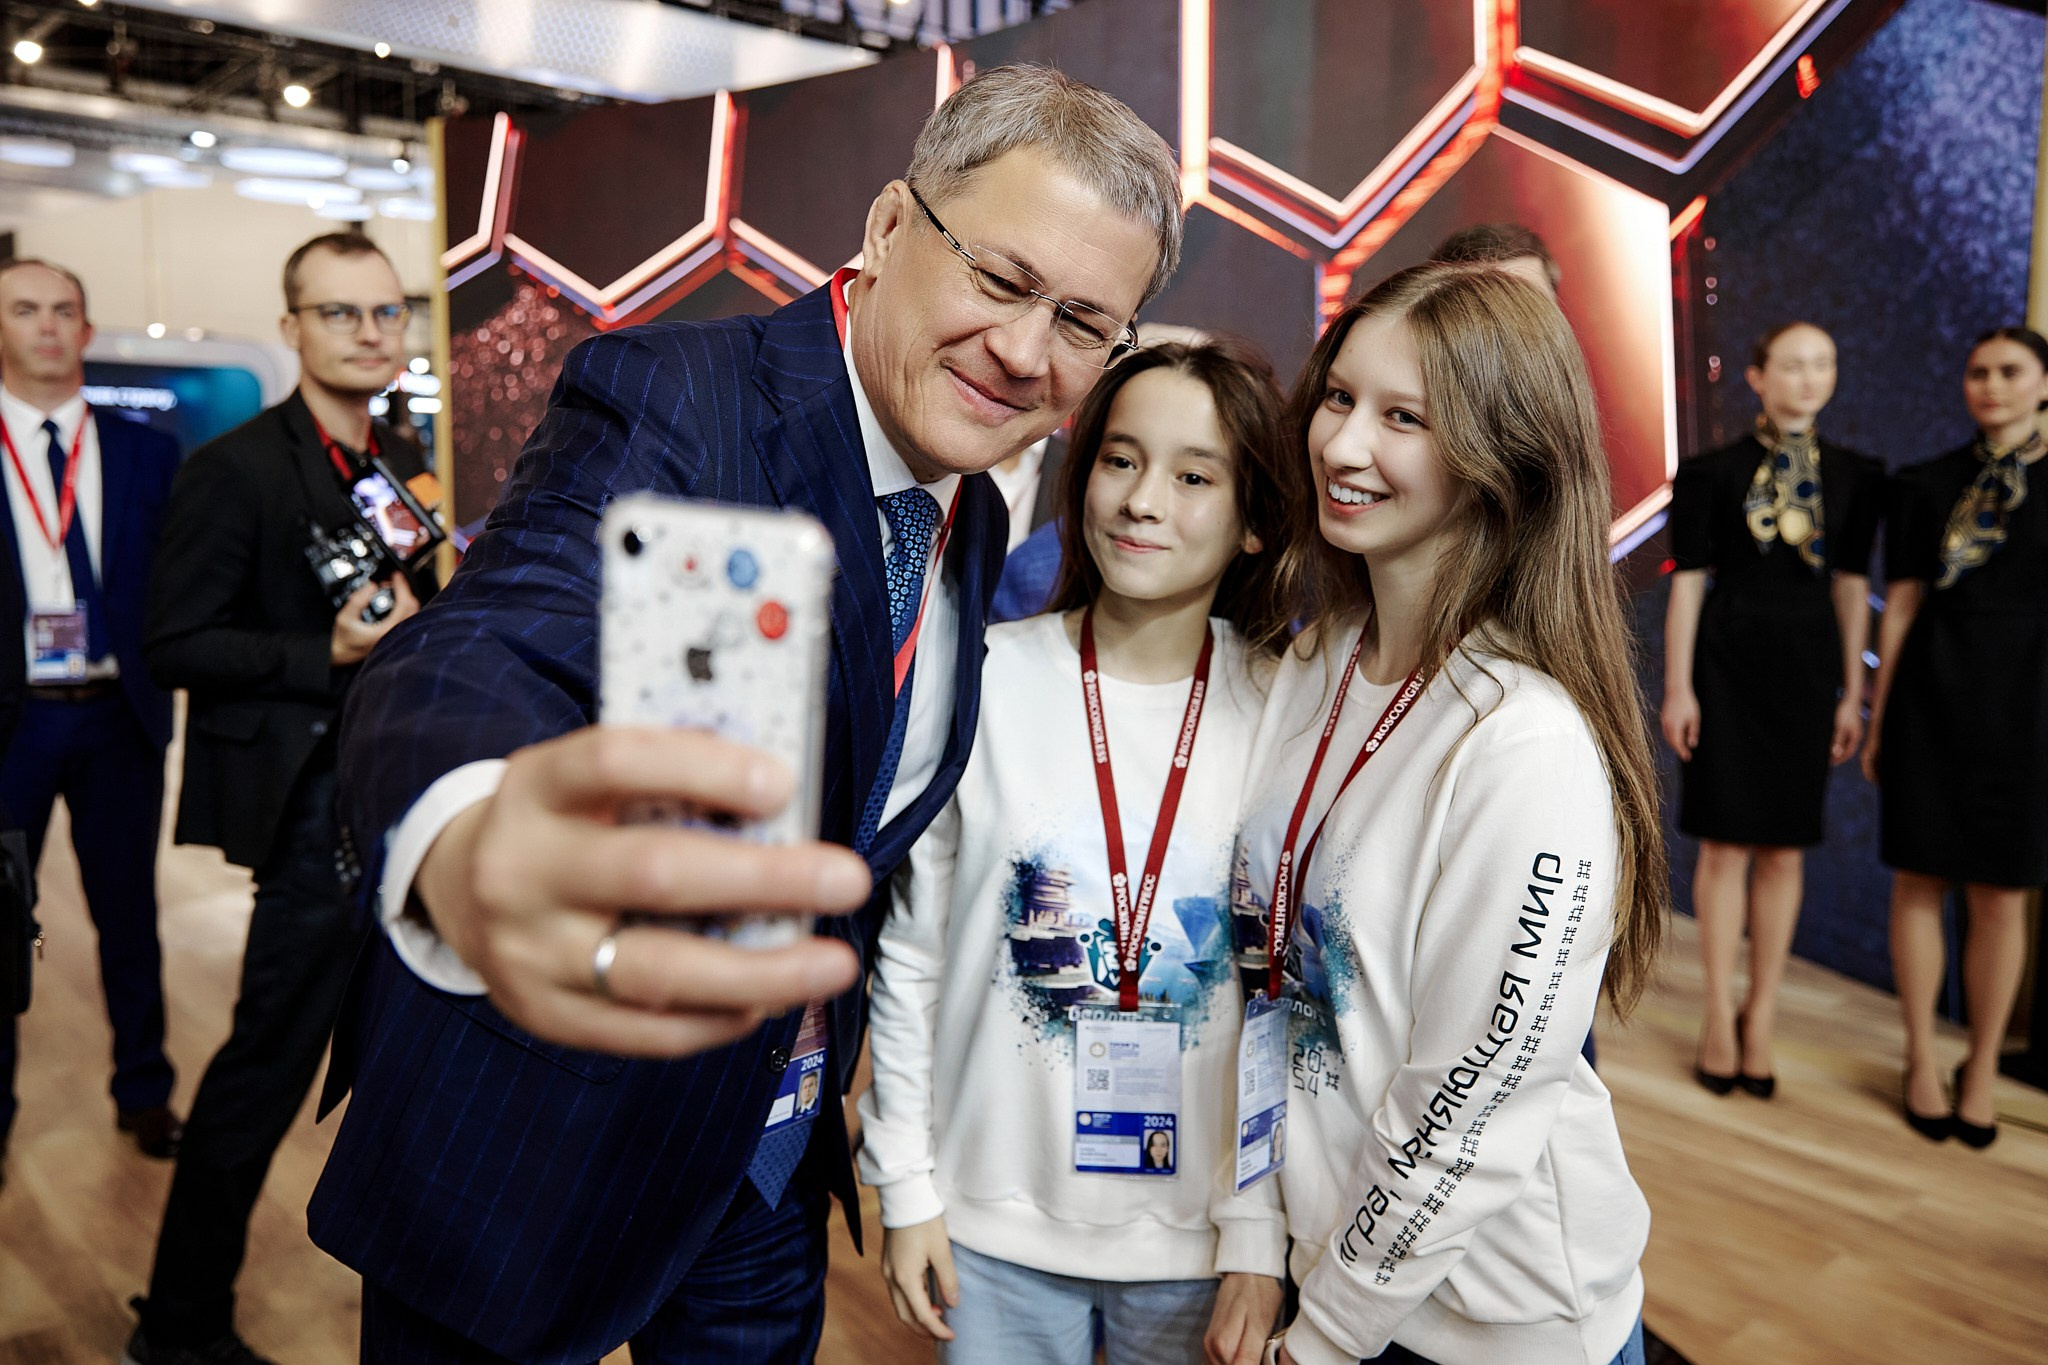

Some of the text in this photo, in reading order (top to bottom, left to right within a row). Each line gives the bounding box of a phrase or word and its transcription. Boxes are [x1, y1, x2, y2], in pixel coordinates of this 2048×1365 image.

[1087, 682, 1108, 764] ROSCONGRESS
[1178, 680, 1205, 756] ROSCONGRESS
[1374, 667, 1425, 740] ROSCONGRE
[1127, 873, 1156, 958] РОСКОНГРЕСС
[1510, 852, 1564, 959] мир
[801, 1054, 824, 1071] 2024
[1143, 1115, 1174, 1128] 2024
